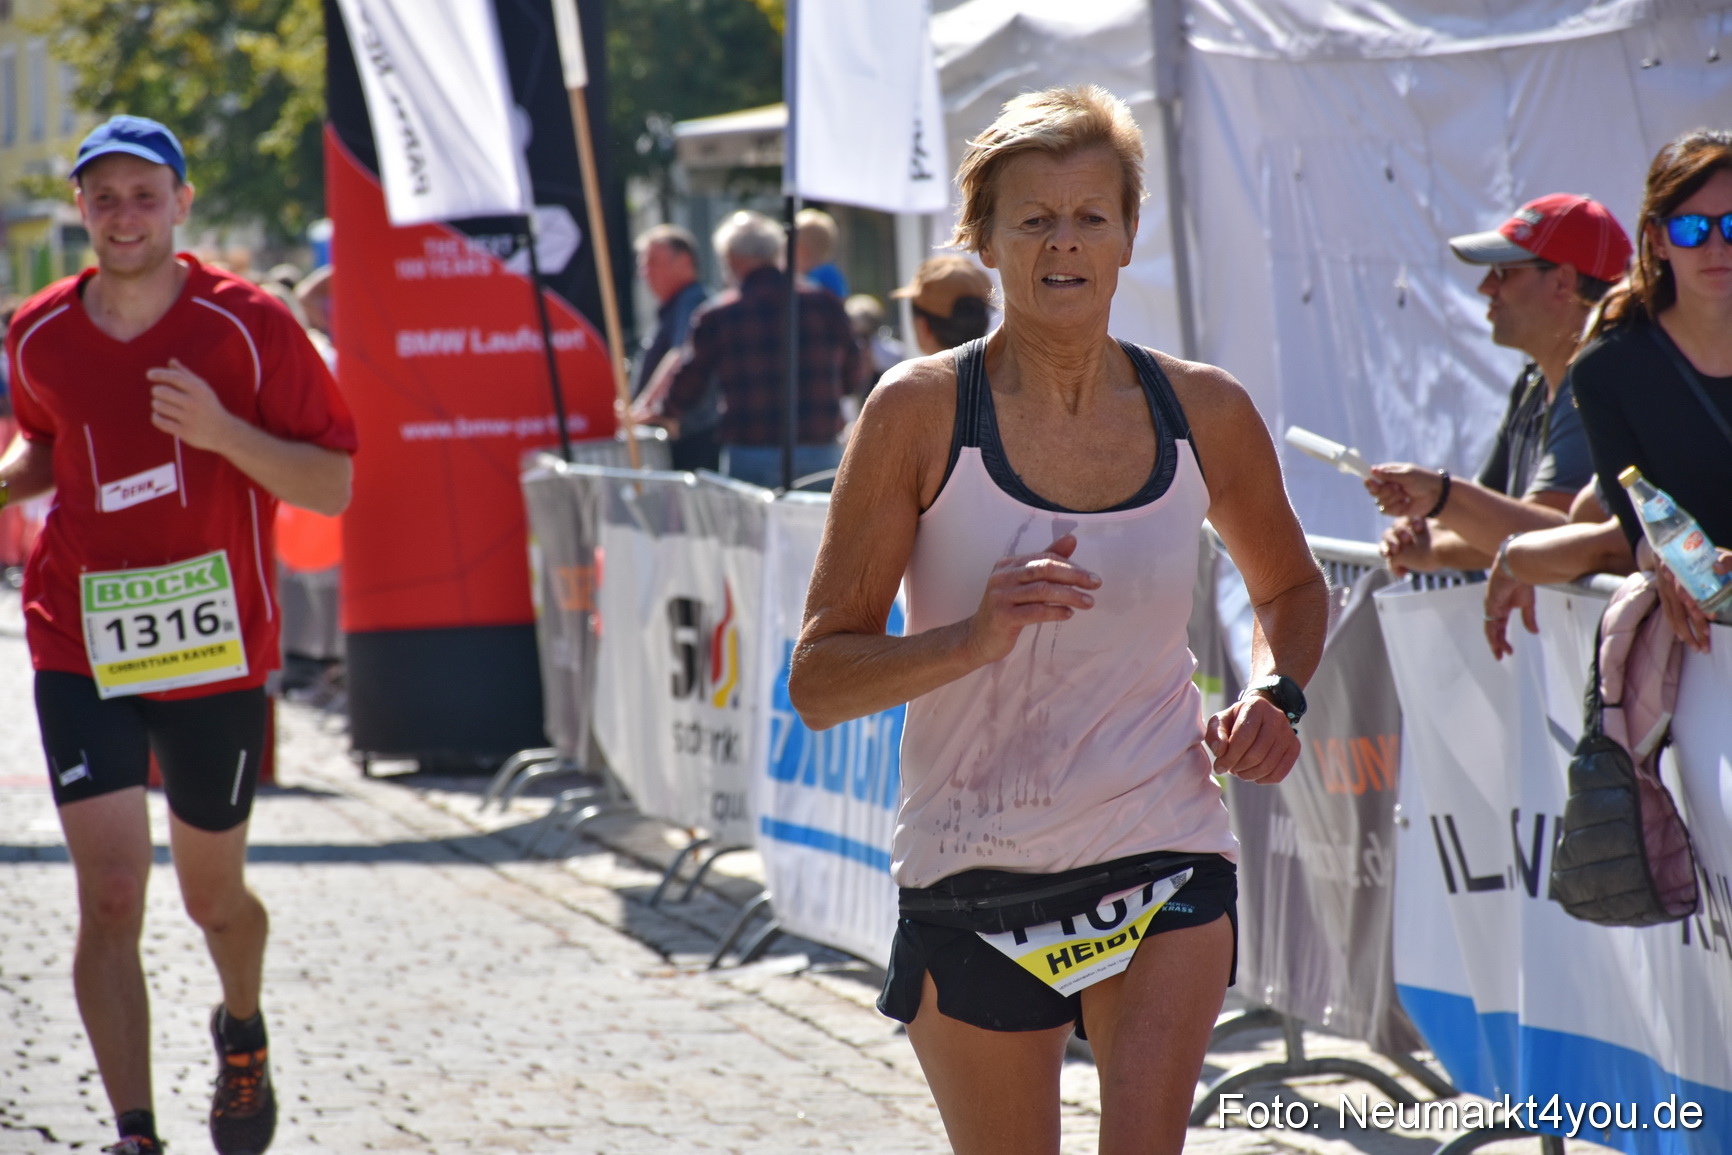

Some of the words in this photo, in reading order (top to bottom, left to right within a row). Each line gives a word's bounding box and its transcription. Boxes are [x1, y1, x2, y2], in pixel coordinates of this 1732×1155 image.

[396, 329, 466, 358] BMW
[96, 560, 216, 604] BOCK
[105, 600, 221, 652] 1316
[108, 654, 180, 674] CHRISTIAN
[1162, 905, 1193, 914] KRASS
[1046, 925, 1141, 976] HEIDI
